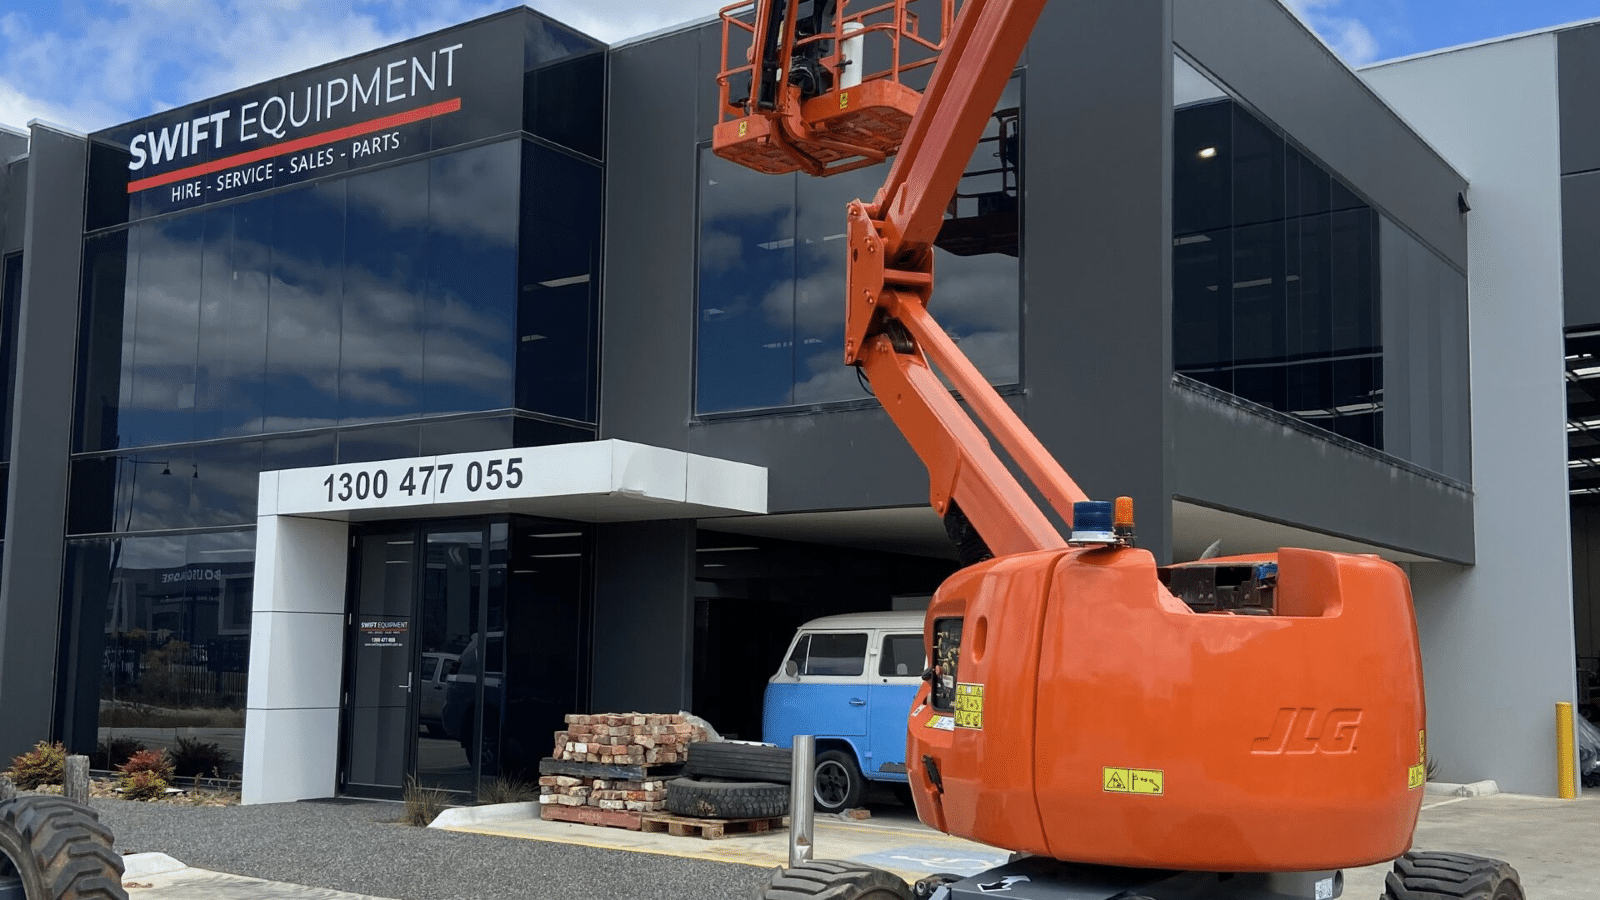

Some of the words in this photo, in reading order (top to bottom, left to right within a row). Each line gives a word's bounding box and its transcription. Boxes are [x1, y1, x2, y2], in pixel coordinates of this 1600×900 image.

[128, 110, 231, 171] SWIFT
[240, 43, 463, 142] EQUIPMENT
[171, 181, 202, 203] HIRE
[216, 163, 273, 192] SERVICE
[290, 148, 334, 174] SALES
[352, 132, 400, 159] PARTS
[323, 469, 388, 503] 1300
[400, 463, 454, 497] 477
[466, 457, 523, 492] 055
[1250, 707, 1363, 755] JLG
